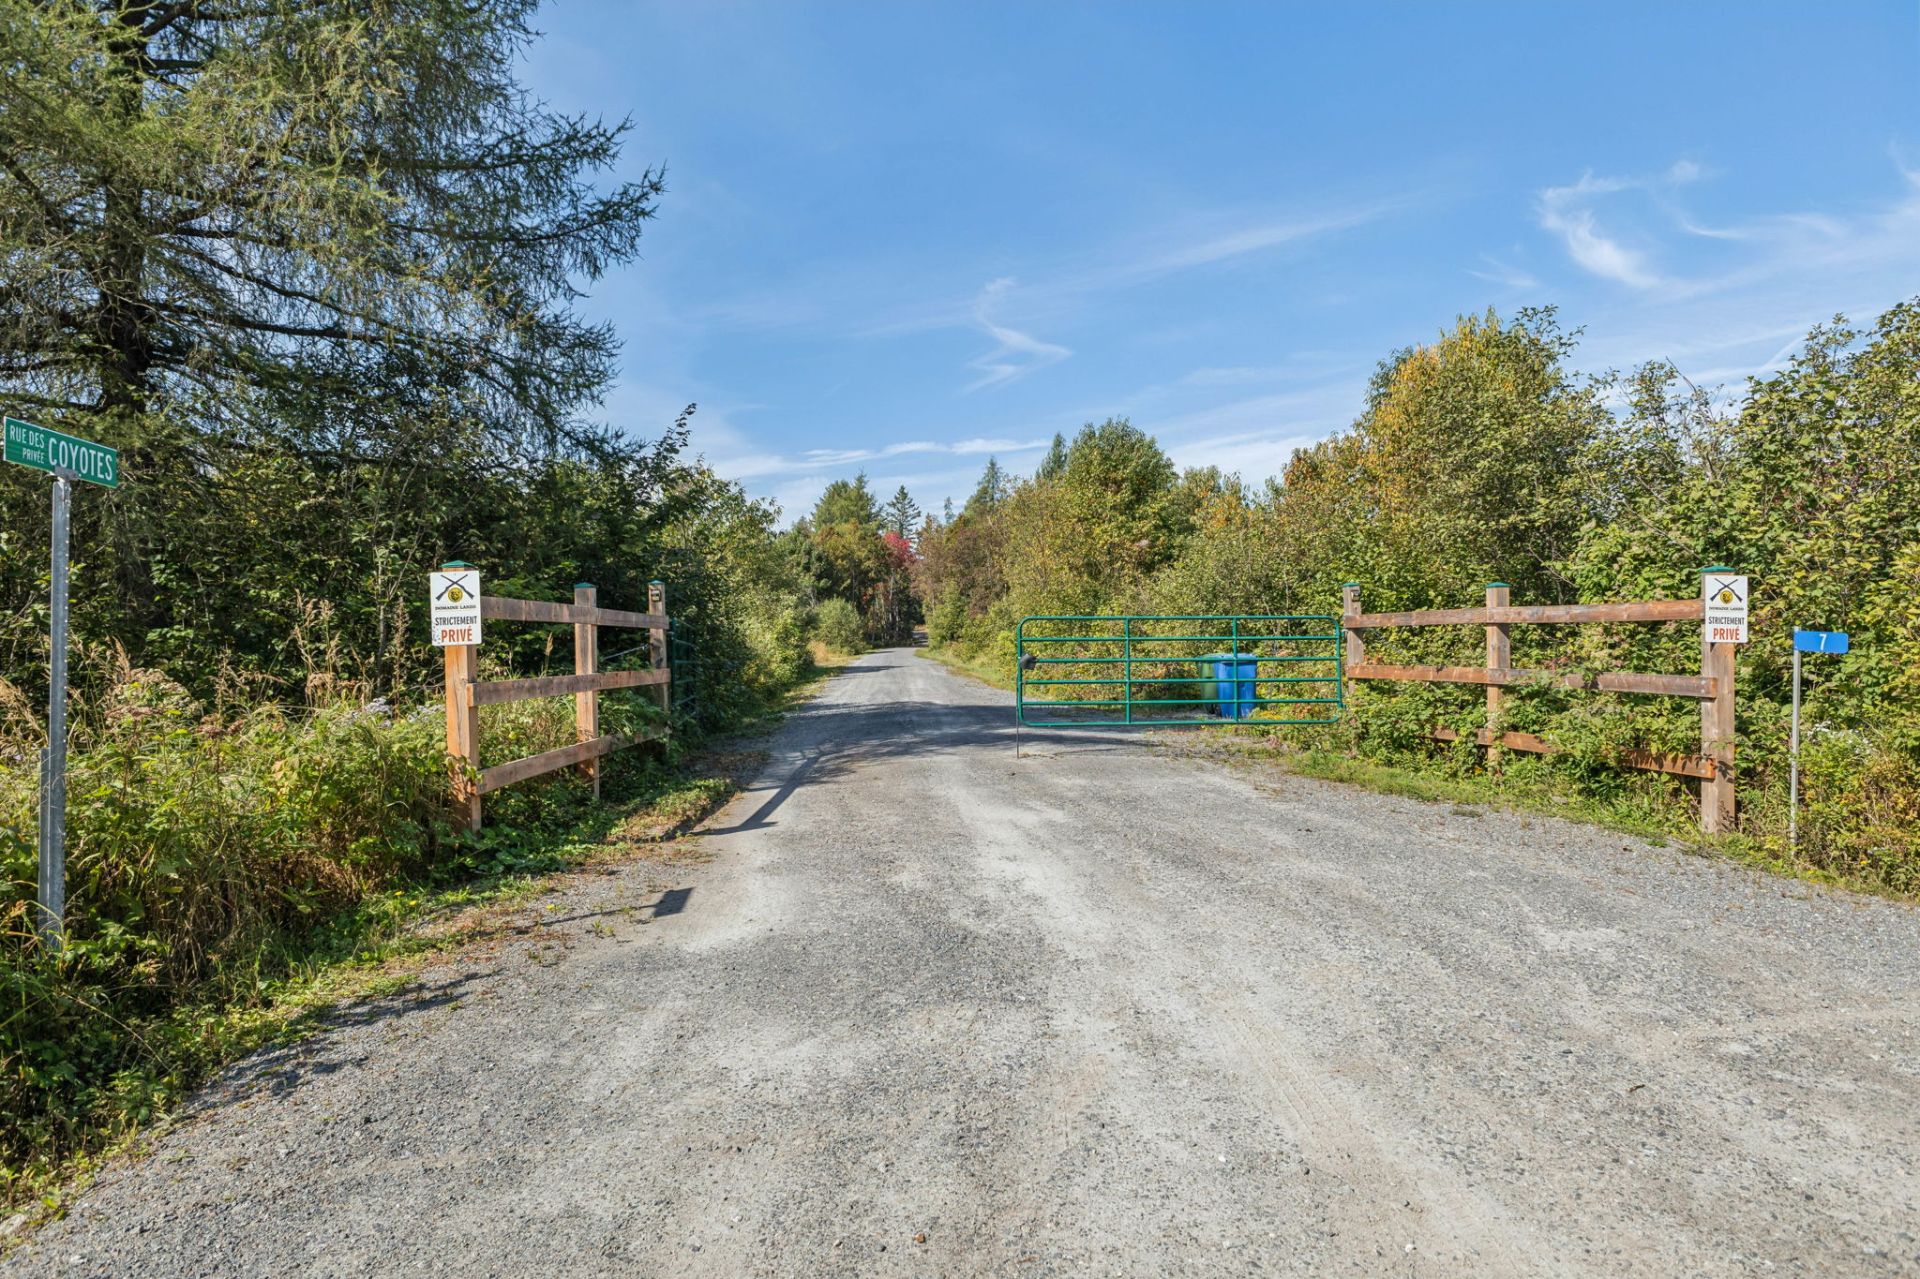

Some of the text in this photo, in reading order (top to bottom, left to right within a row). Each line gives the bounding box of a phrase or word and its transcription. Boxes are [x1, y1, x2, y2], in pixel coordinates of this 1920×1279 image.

[9, 425, 113, 481] RUE DES COYOTES
[22, 447, 45, 464] PRIVÉE
[435, 616, 477, 626] STRICTEMENT
[1708, 616, 1745, 625] STRICTEMENT
[441, 625, 473, 643] PRIVÉ
[1713, 626, 1740, 640] PRIVÉ
[1819, 633, 1827, 651] 7
